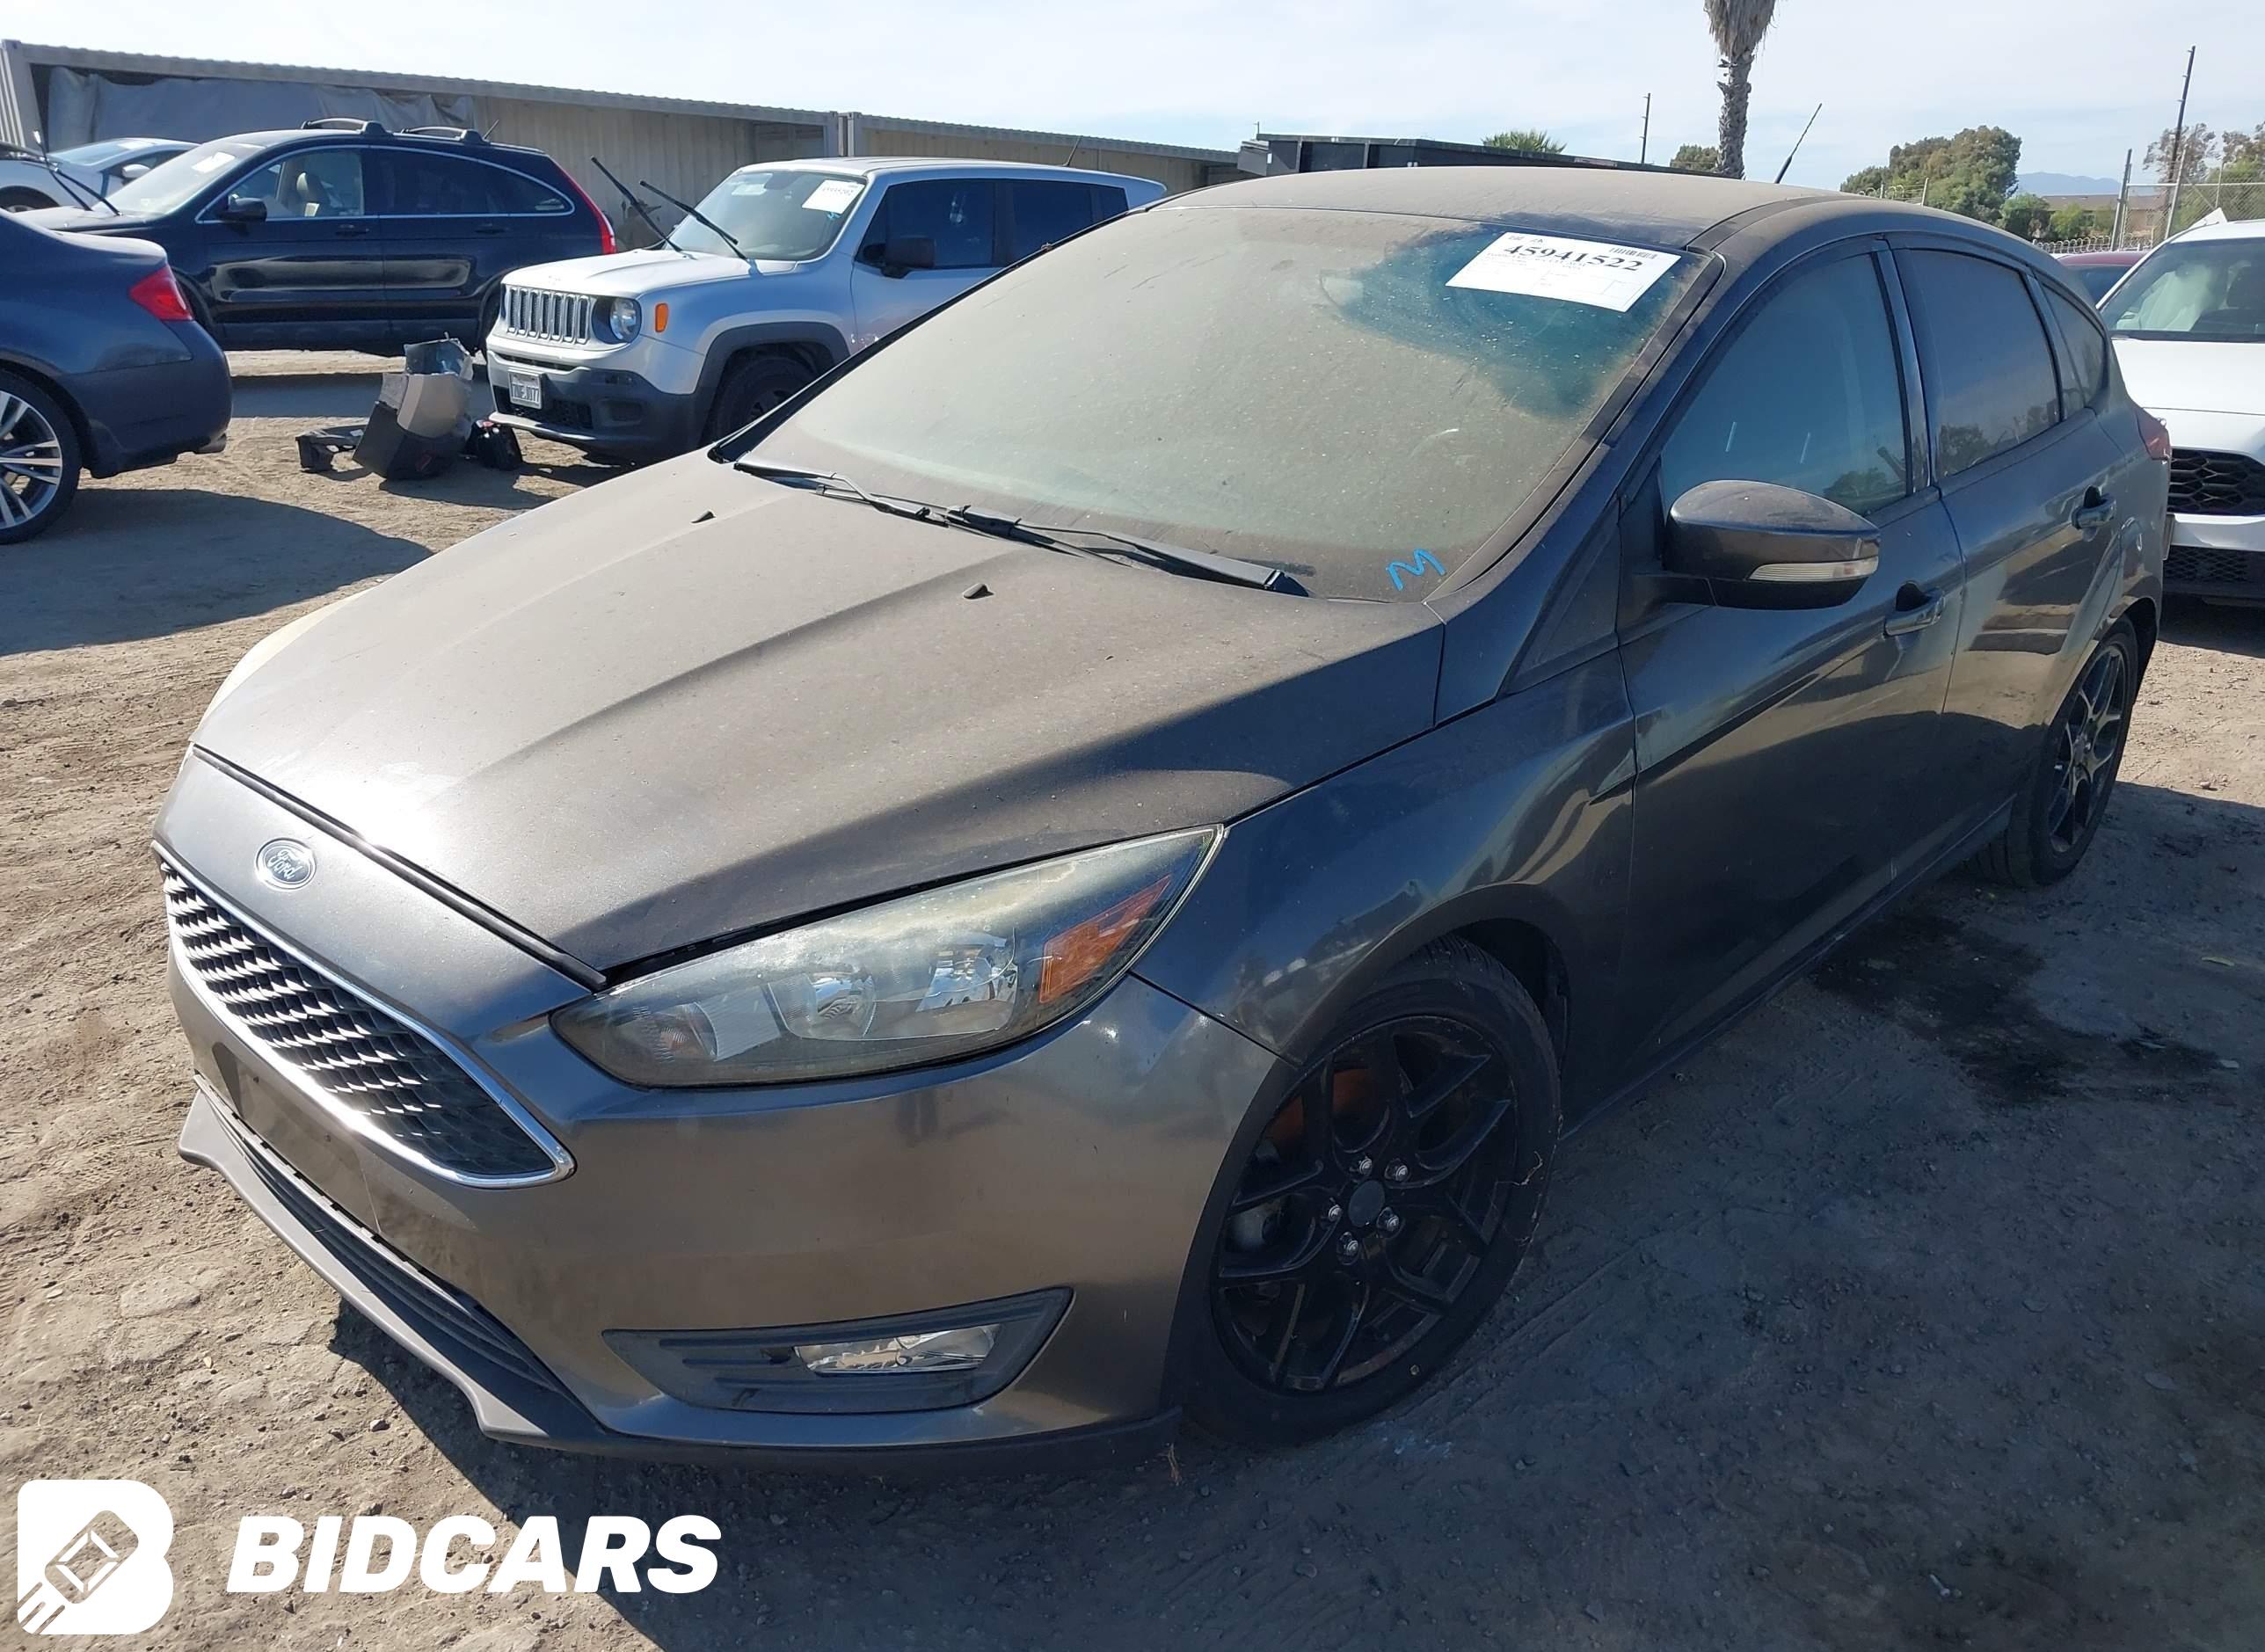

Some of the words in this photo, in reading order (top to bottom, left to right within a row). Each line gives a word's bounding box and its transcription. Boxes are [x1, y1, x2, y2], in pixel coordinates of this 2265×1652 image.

[1504, 244, 1643, 272] 45941522
[1387, 549, 1446, 591] M
[266, 848, 303, 879] Ford
